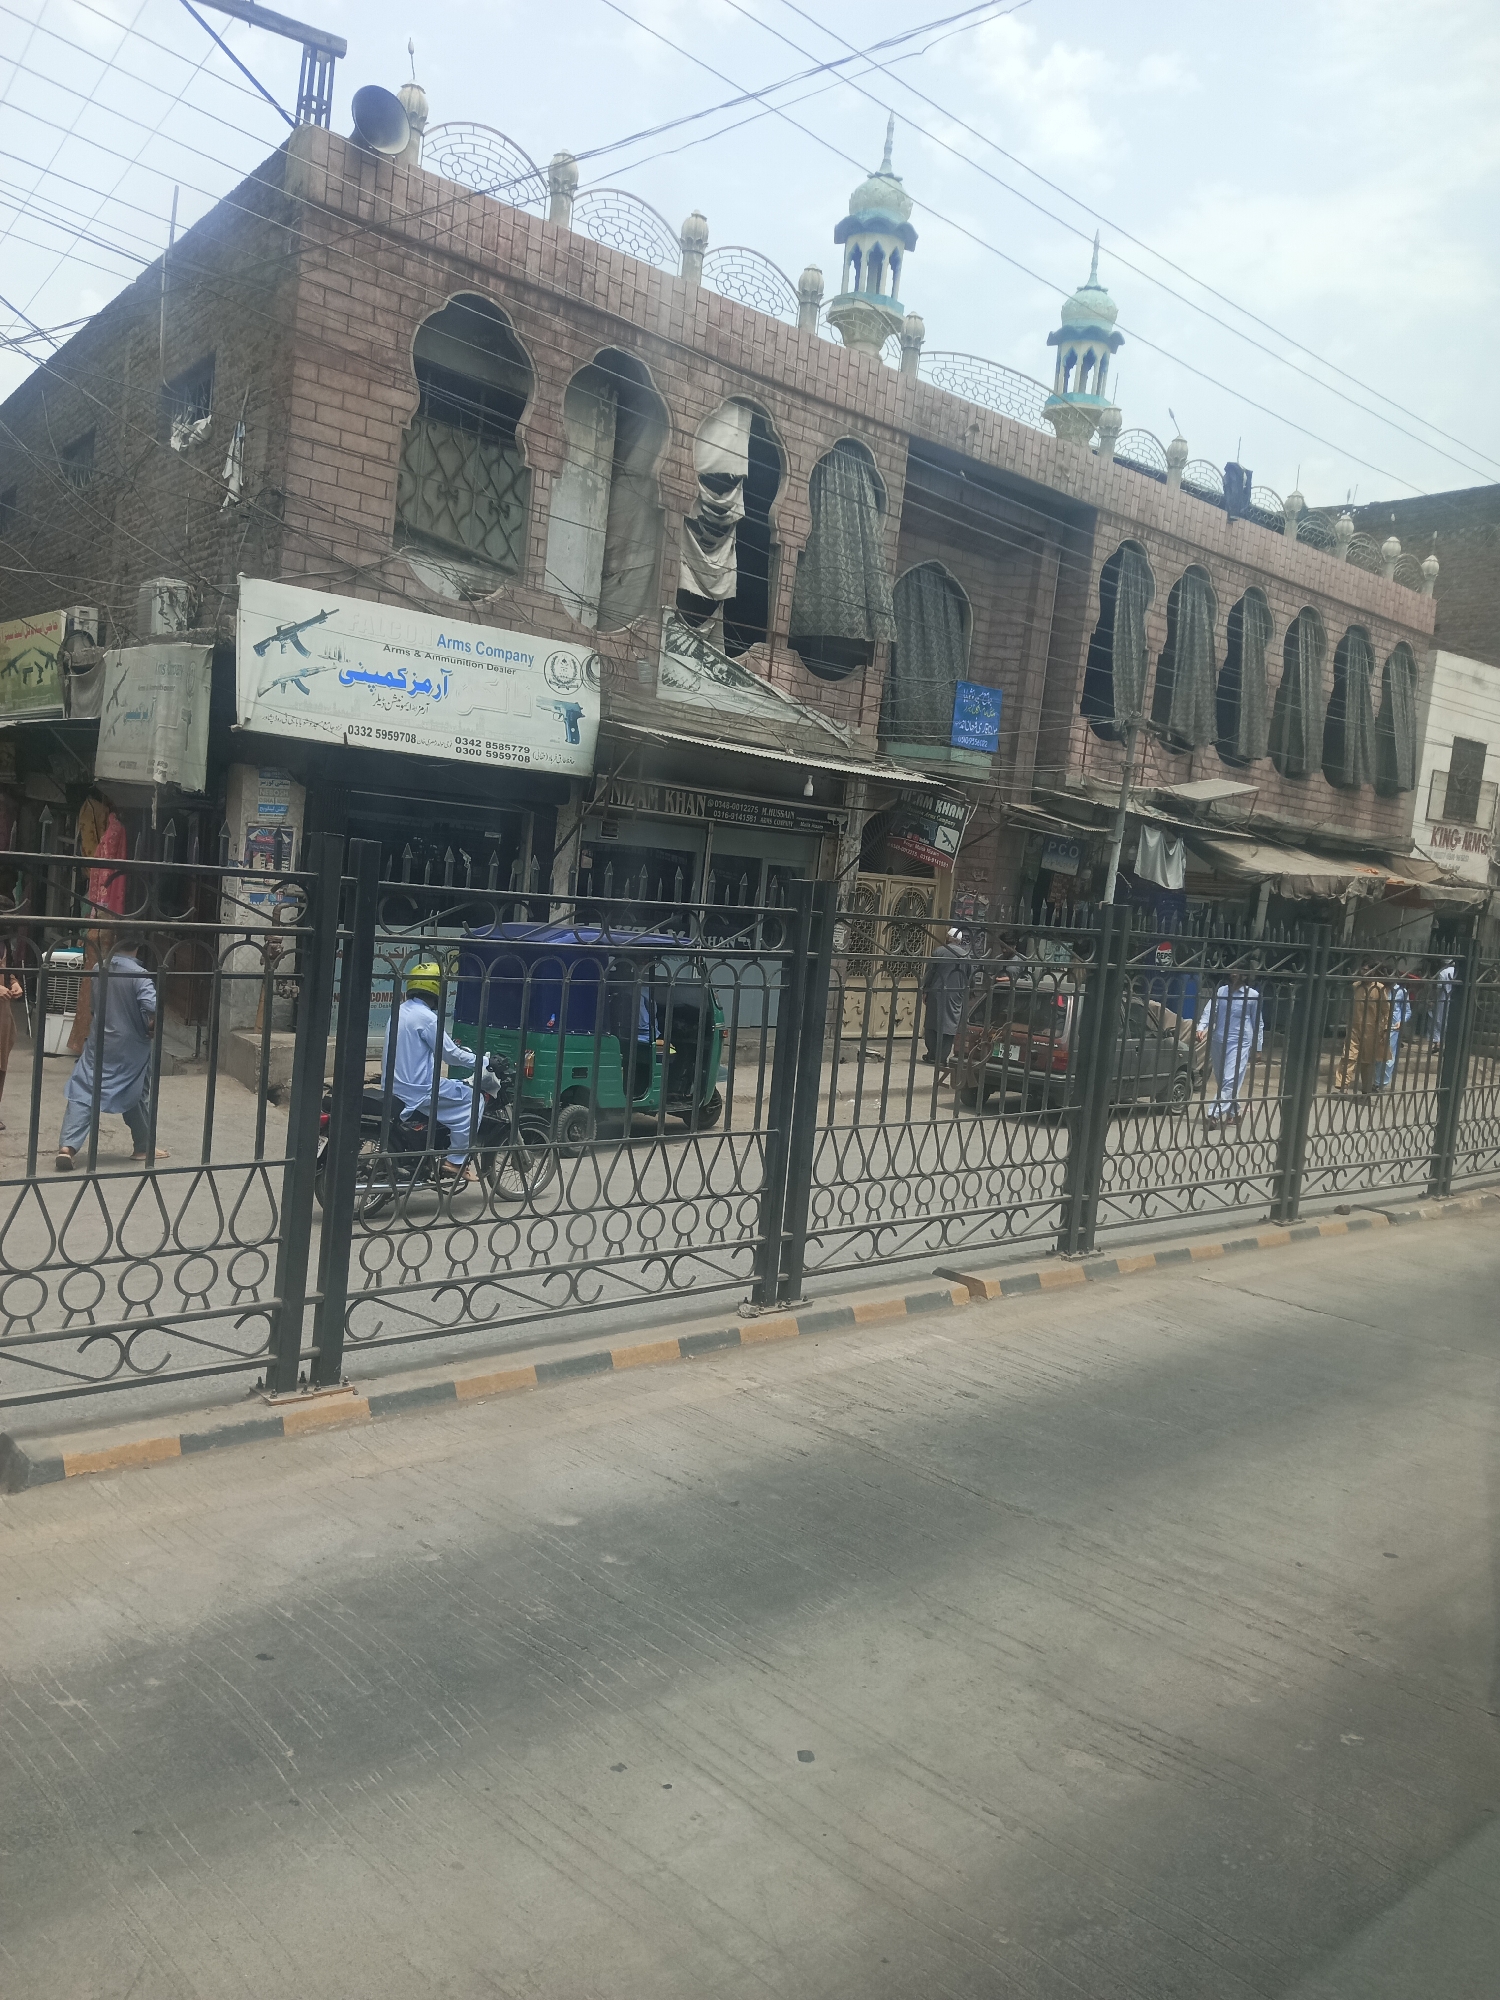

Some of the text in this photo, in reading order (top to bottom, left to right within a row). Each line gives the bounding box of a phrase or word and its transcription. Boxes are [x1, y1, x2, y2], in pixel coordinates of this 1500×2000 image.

[383, 644, 516, 676] Arms & Ammunition Dealer
[437, 633, 471, 653] Arms
[475, 641, 535, 667] Company
[339, 661, 453, 700] آرمز کمپنی
[347, 725, 417, 744] 0332 5959708
[455, 736, 531, 754] 0342 8585779
[455, 746, 531, 763] 0300 5959708
[259, 789, 289, 797] NEBOSH
[664, 790, 706, 817] KHAN
[935, 800, 965, 820] KHAN
[1047, 841, 1079, 858] PCO
[1431, 825, 1488, 855] KING ARMS
